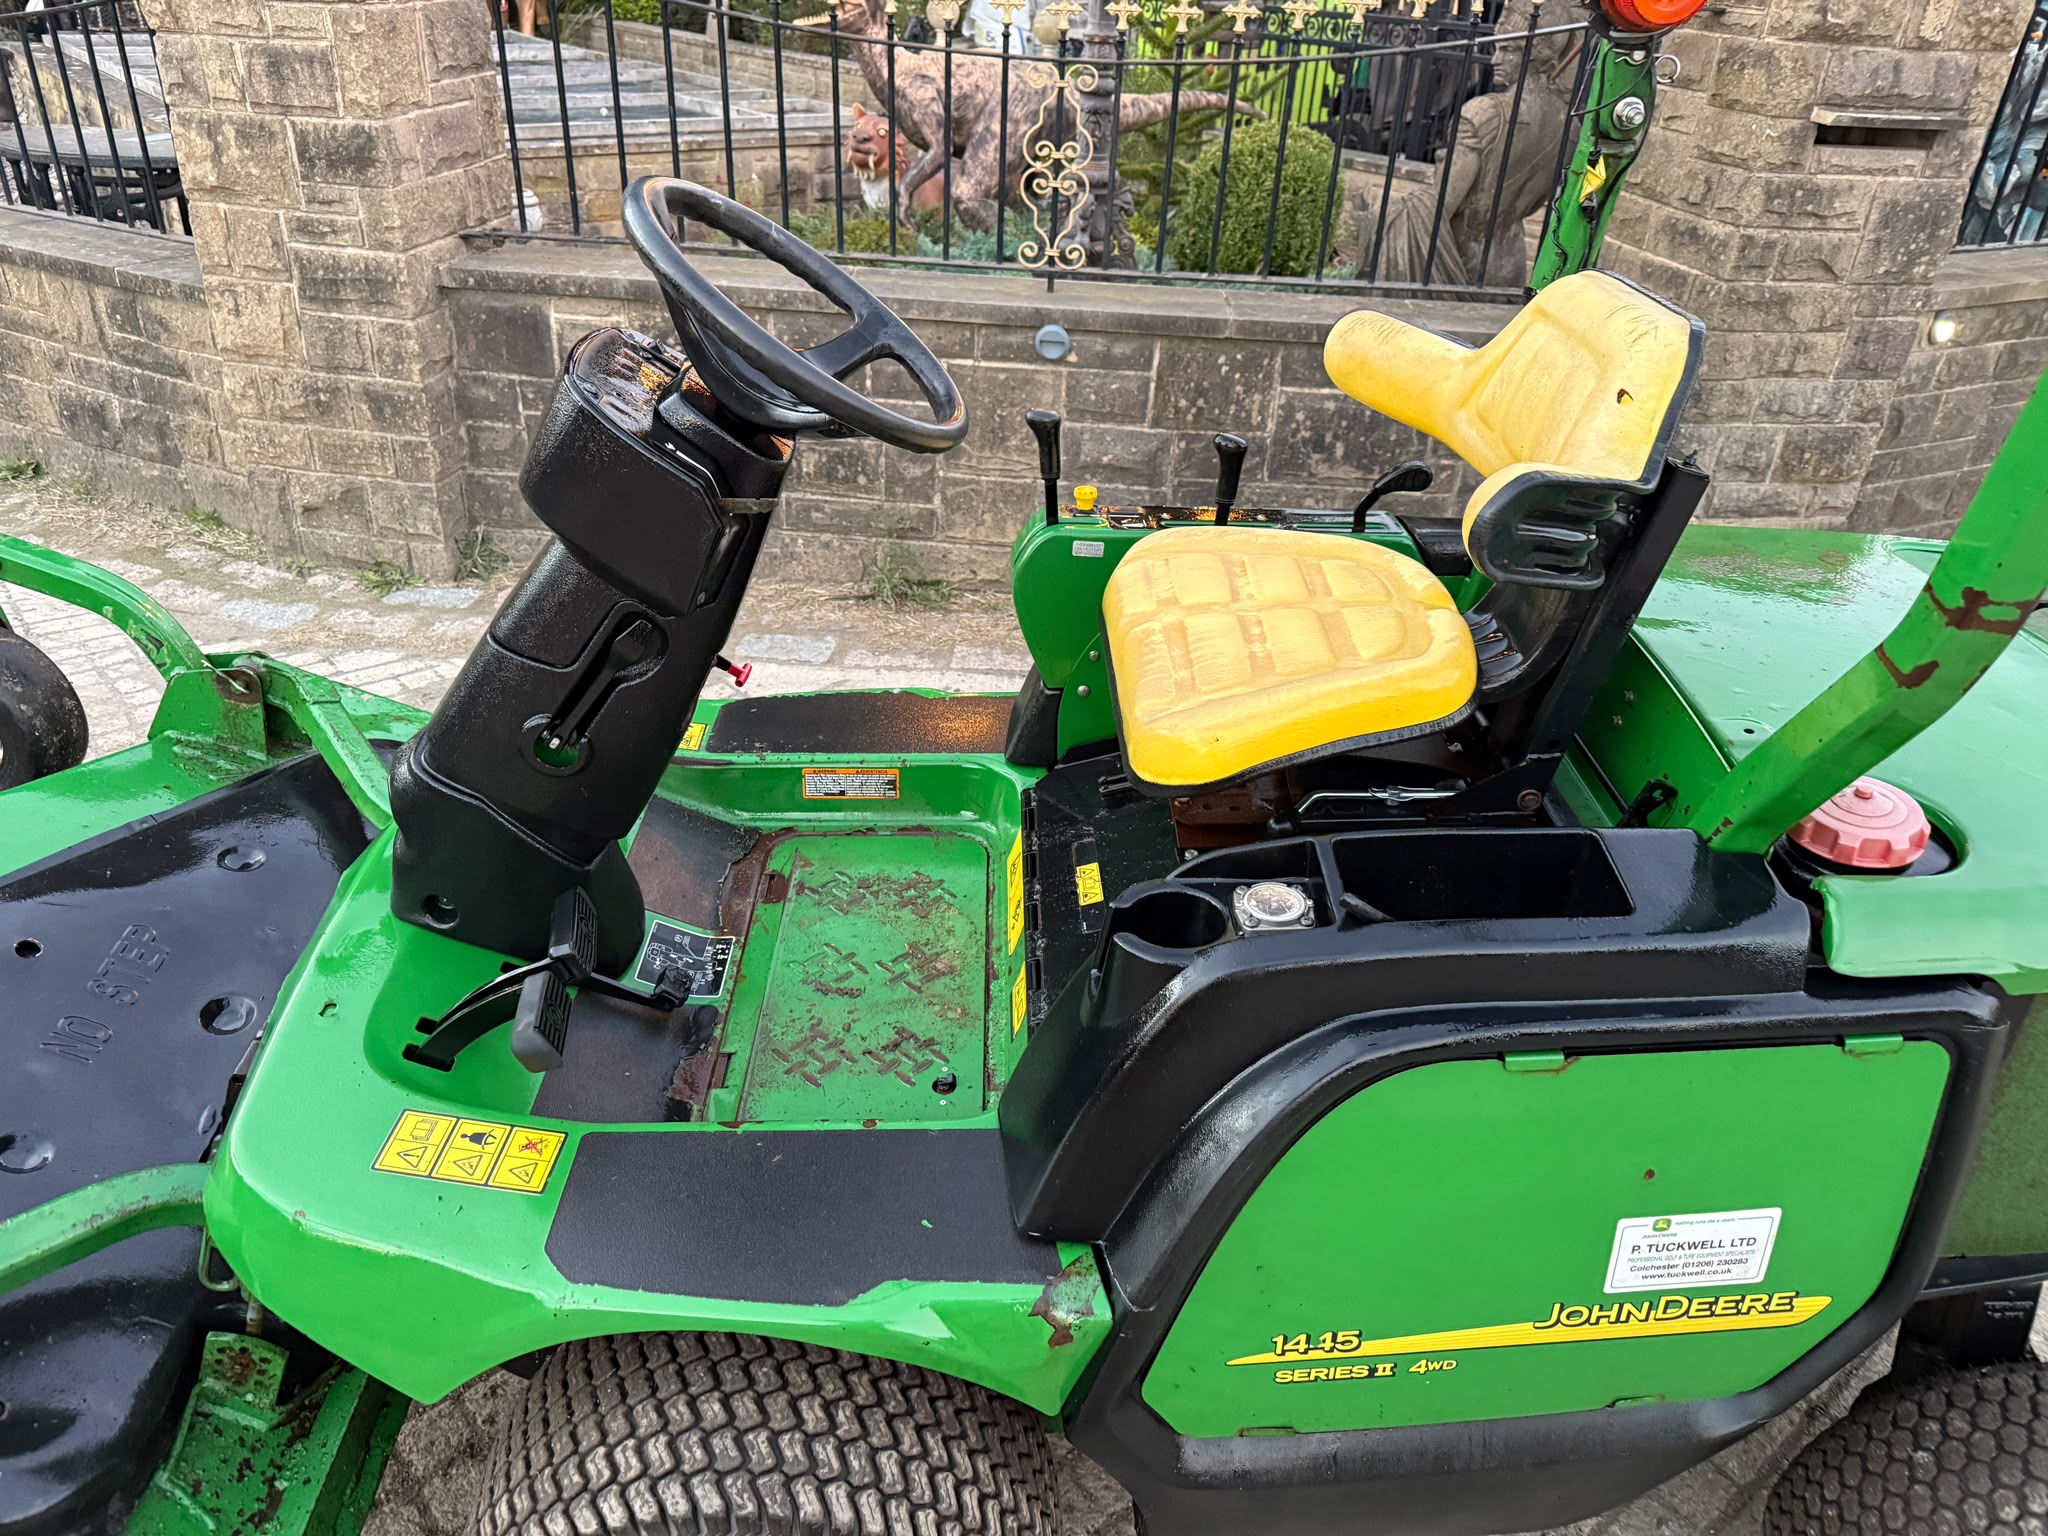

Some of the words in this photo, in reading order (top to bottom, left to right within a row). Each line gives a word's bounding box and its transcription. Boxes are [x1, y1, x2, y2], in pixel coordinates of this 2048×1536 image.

[40, 1015, 113, 1063] NO
[87, 923, 170, 1005] STEP
[1631, 1244, 1641, 1254] P.
[1646, 1239, 1726, 1253] TUCKWELL
[1730, 1237, 1757, 1248] LTD
[1627, 1255, 1664, 1263] PROFESSIONAL
[1683, 1252, 1696, 1260] TURF
[1696, 1251, 1725, 1259] EQUIPMENT
[1630, 1263, 1680, 1272] Colchester
[1682, 1259, 1714, 1270] (01206)
[1716, 1258, 1749, 1266] 230283
[1641, 1267, 1733, 1280] www.tuckwell.co.uk
[1533, 1301, 1650, 1329] JOHN
[1654, 1291, 1799, 1321] DEERE
[1271, 1329, 1362, 1356] 1445
[1274, 1364, 1370, 1384] SERIES
[1374, 1362, 1397, 1377] II
[1407, 1359, 1458, 1375] 4WD
